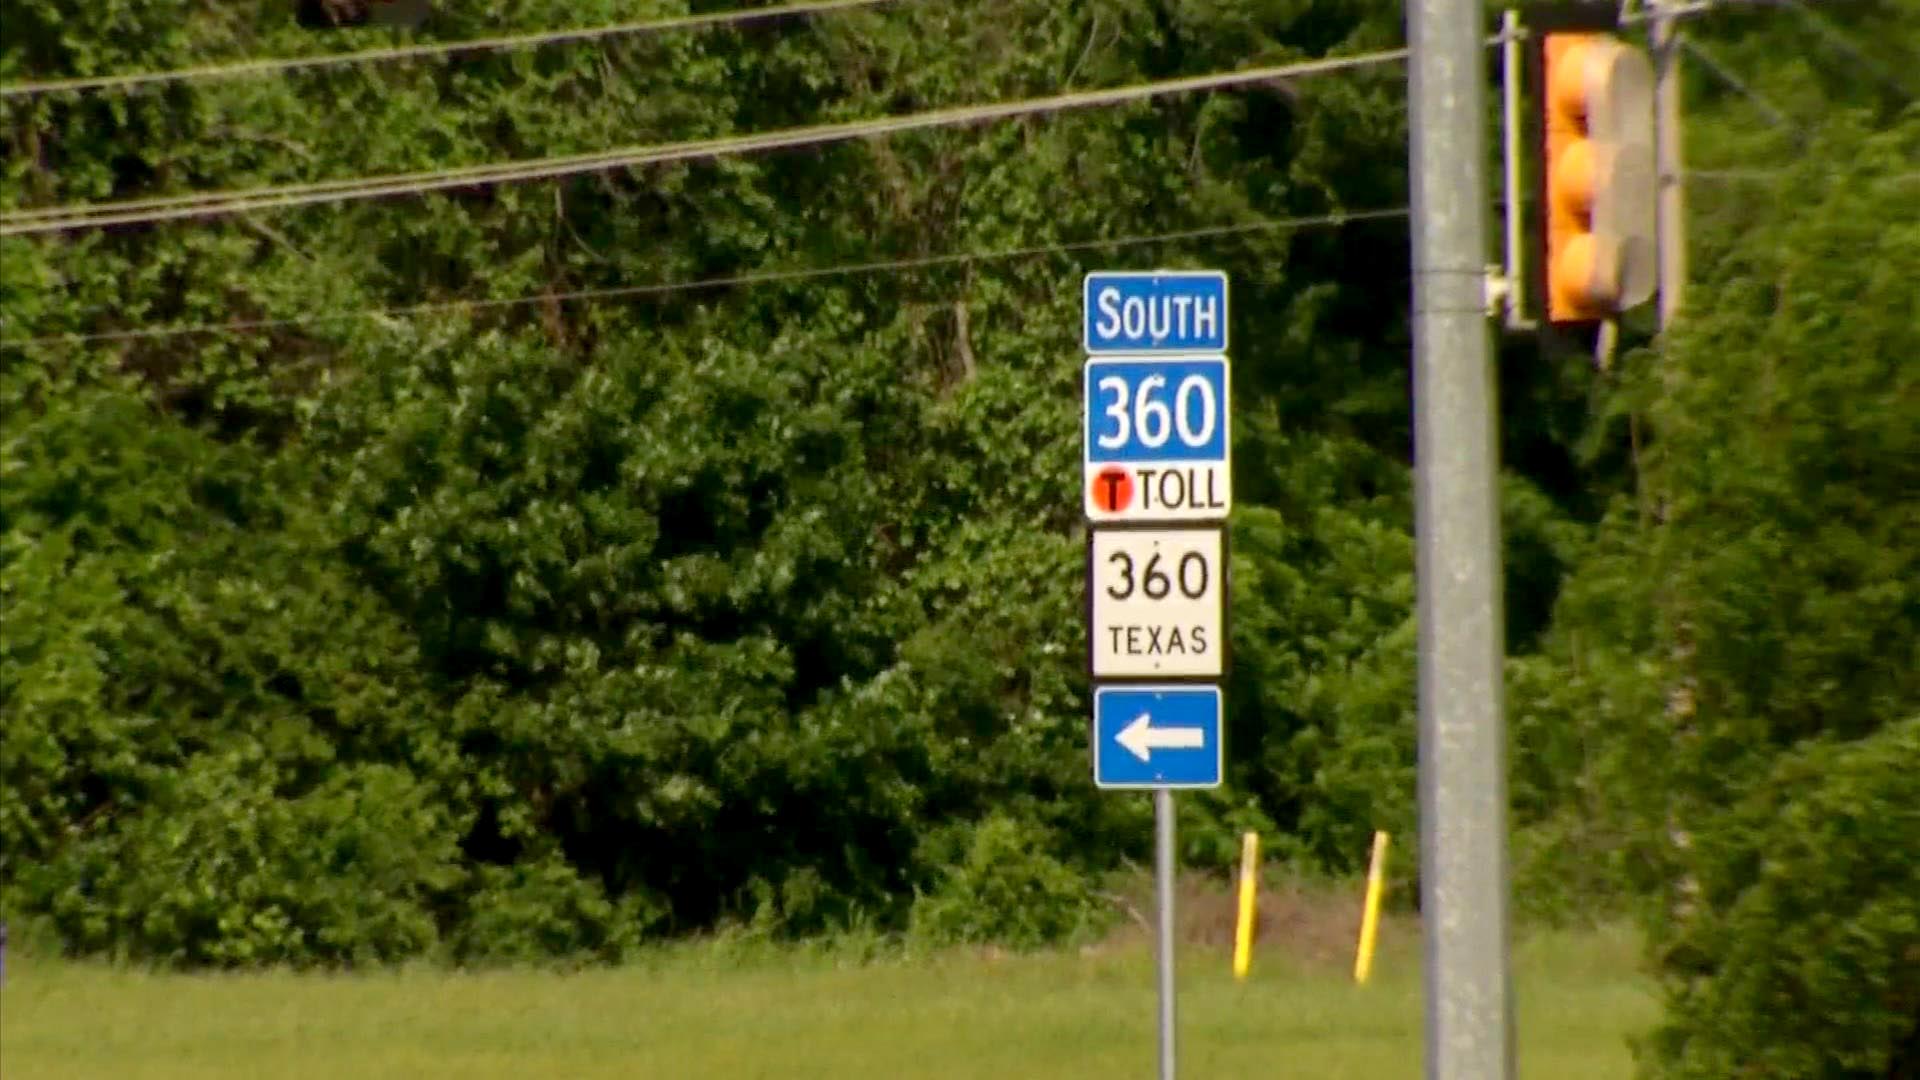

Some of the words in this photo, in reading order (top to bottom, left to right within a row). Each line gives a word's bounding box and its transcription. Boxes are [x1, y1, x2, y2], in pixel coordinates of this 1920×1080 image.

[1095, 286, 1217, 340] SOUTH
[1098, 374, 1217, 449] 360
[1101, 471, 1126, 511] T
[1137, 468, 1225, 510] TOLL
[1106, 551, 1209, 601] 360
[1108, 625, 1208, 655] TEXAS
